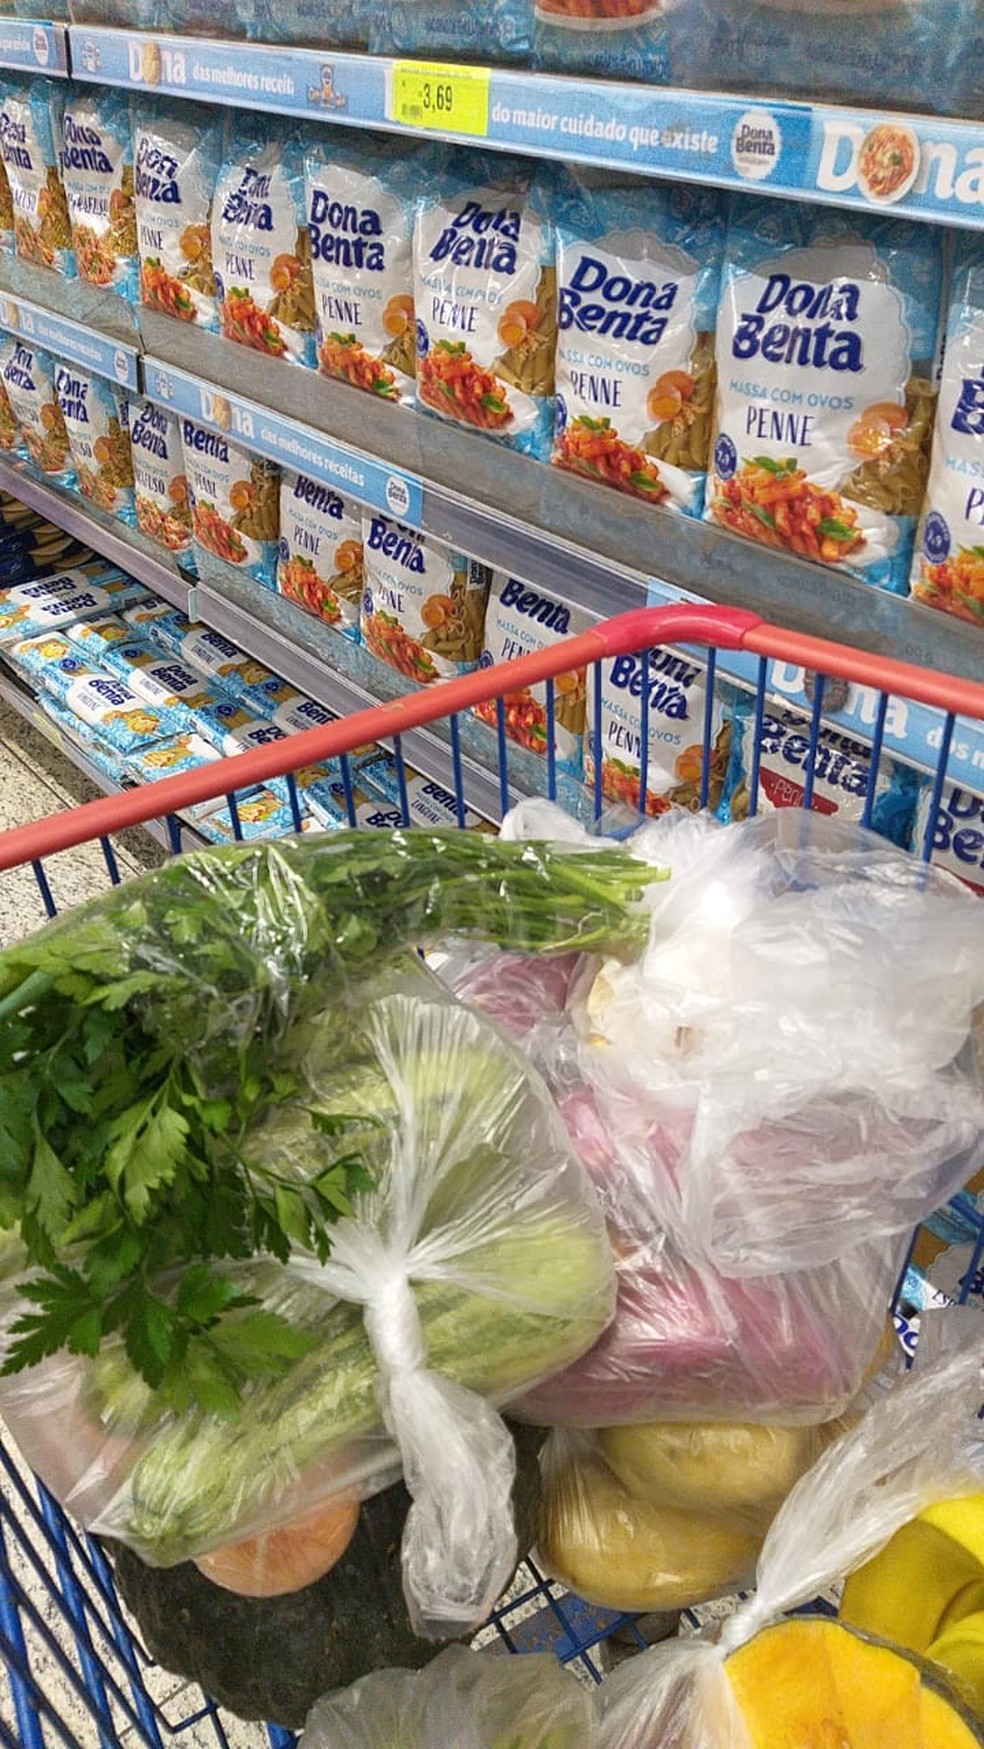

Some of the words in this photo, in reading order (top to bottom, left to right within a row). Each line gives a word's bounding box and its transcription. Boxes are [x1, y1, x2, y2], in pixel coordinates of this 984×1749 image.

[423, 83, 453, 114] 3,69
[492, 102, 510, 123] do
[512, 105, 557, 131] maior
[560, 110, 625, 142] cuidado
[628, 121, 660, 151] que
[742, 124, 773, 142] Dona
[735, 137, 775, 156] Benta
[310, 190, 384, 236] Dona
[307, 222, 386, 271] Benta
[353, 286, 383, 300] OVOS
[569, 255, 680, 311] Dona
[756, 273, 861, 323] Dona
[321, 294, 362, 326] PENNE
[431, 296, 479, 333] PENNE
[558, 287, 669, 346] Benta
[731, 312, 865, 373] Benta
[586, 354, 613, 370] COM
[614, 360, 651, 377] OVOS
[570, 370, 623, 408] PENNE
[729, 379, 768, 400] MASSA
[769, 387, 807, 406] COM
[807, 393, 854, 411] OVOS
[60, 398, 89, 424] enta
[746, 404, 815, 448] PENNE
[293, 475, 345, 521] Benta
[293, 525, 321, 557] PENNE
[499, 578, 572, 635] Benta
[297, 702, 335, 725] Bent
[760, 713, 869, 798] Benta
[926, 727, 970, 760] ds
